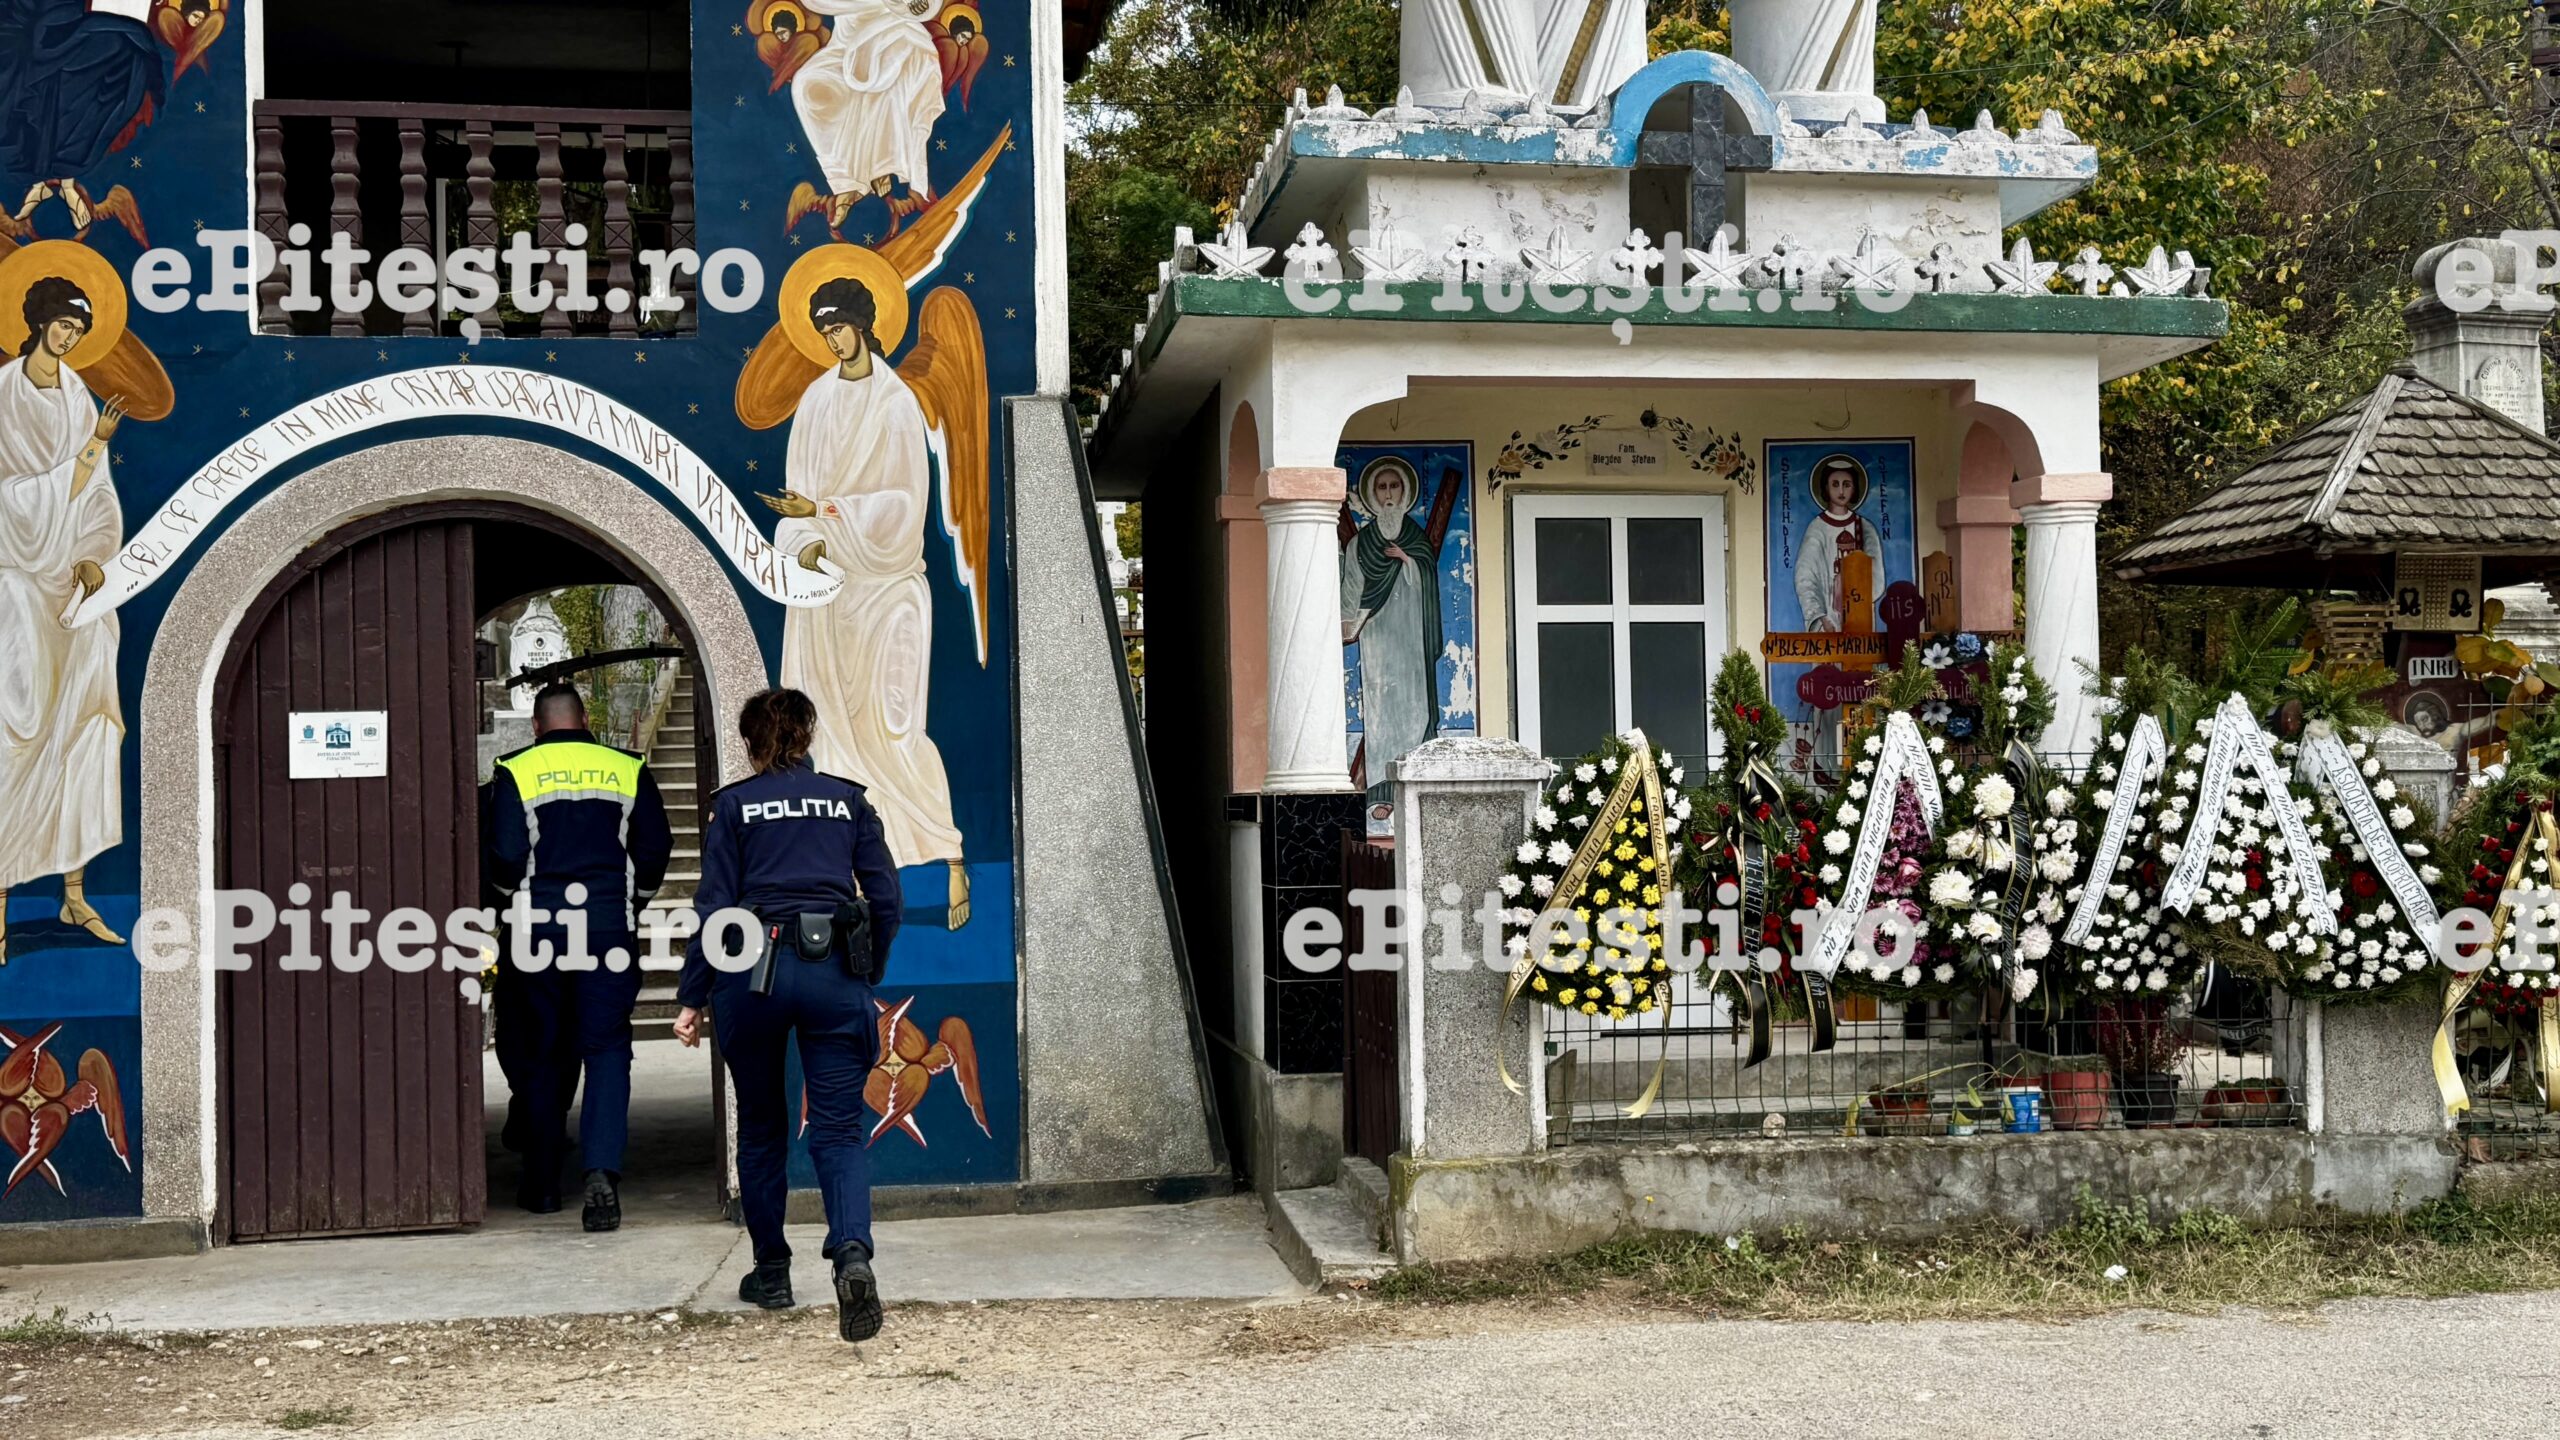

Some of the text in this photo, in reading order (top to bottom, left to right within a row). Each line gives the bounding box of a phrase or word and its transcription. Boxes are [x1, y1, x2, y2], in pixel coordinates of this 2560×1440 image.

[2412, 659, 2454, 676] INRI
[742, 798, 852, 824] POLITIA
[1745, 856, 1764, 918] REGRETE
[2094, 861, 2107, 889] VOM
